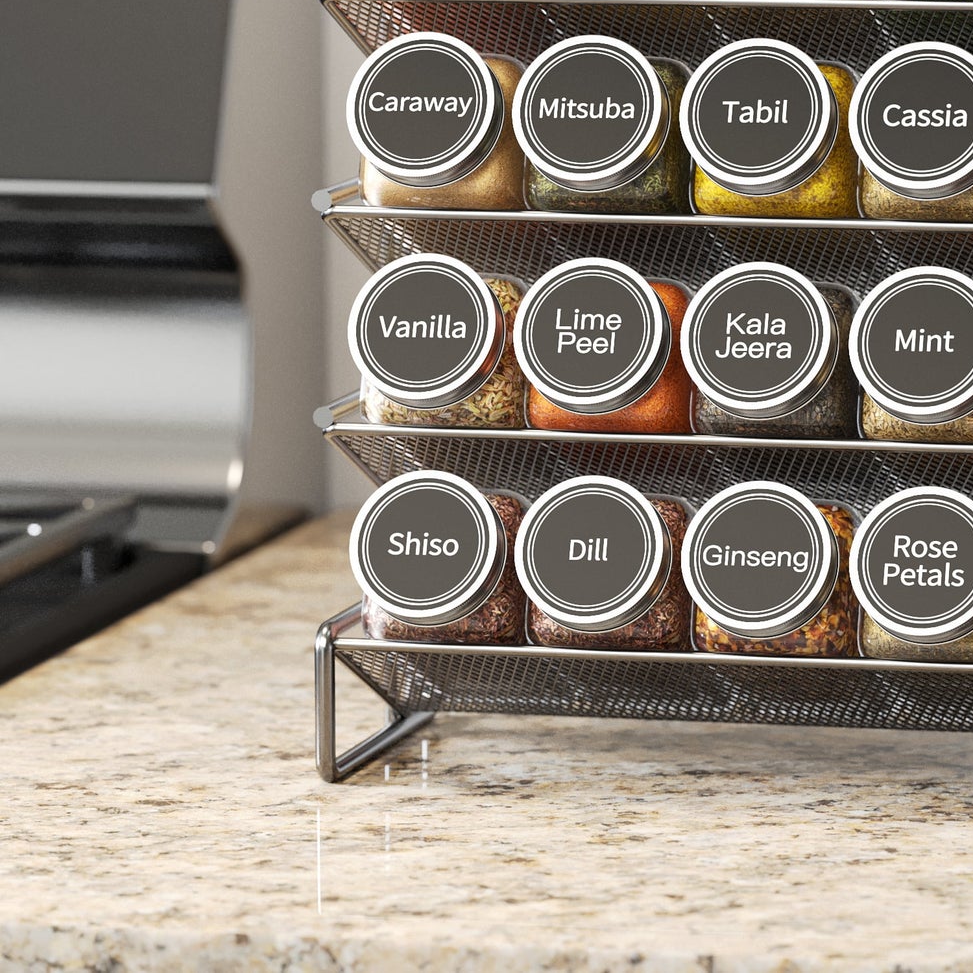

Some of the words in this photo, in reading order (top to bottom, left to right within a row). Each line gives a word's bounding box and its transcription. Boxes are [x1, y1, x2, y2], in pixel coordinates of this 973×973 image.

[368, 91, 474, 118] Caraway
[538, 96, 635, 120] Mitsuba
[722, 99, 788, 124] Tabil
[882, 103, 968, 128] Cassia
[378, 313, 467, 339] Vanilla
[555, 308, 623, 331] Lime
[725, 312, 787, 336] Kala
[557, 331, 616, 355] Peel
[714, 335, 793, 360] Jeera
[894, 328, 955, 353] Mint
[387, 530, 460, 557] Shiso
[568, 537, 609, 562] Dill
[893, 534, 959, 559] Rose
[702, 544, 809, 573] Ginseng
[882, 561, 965, 588] Petals
